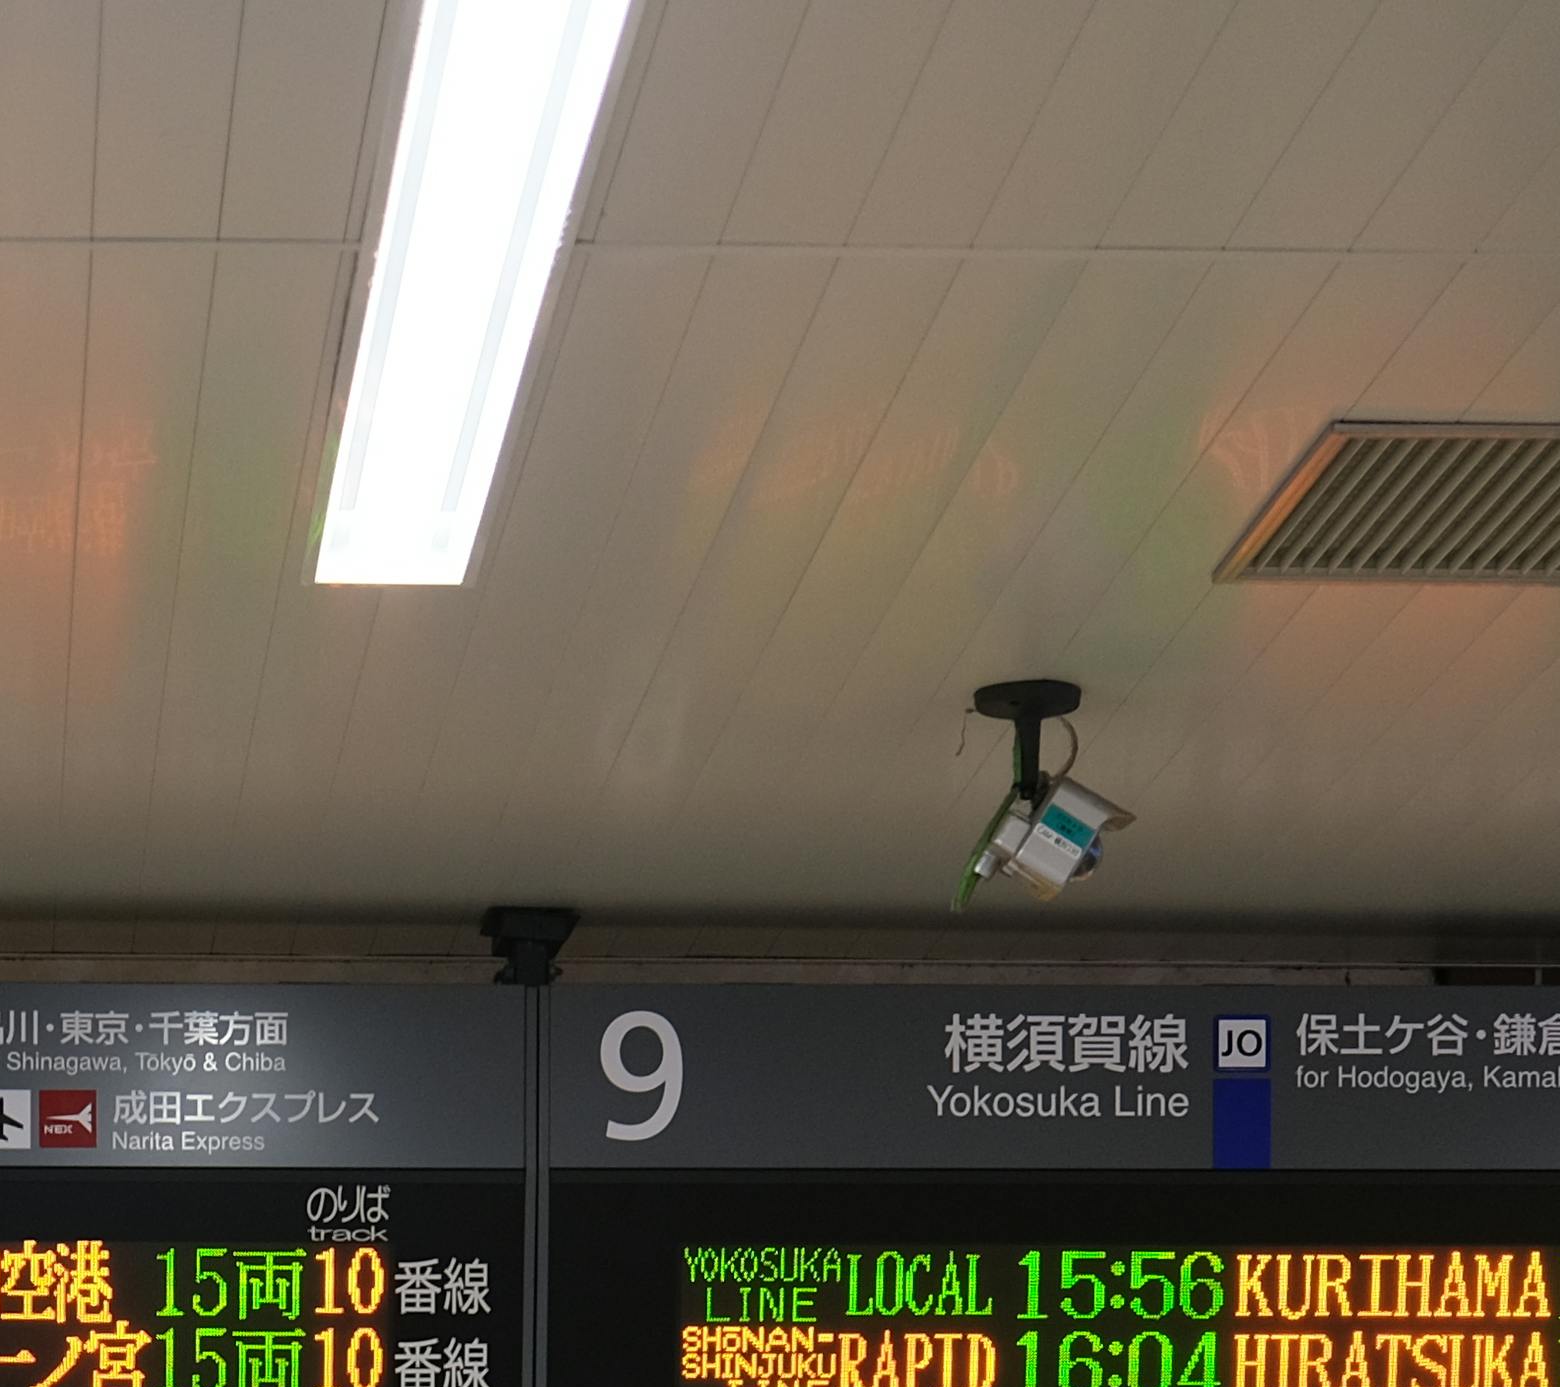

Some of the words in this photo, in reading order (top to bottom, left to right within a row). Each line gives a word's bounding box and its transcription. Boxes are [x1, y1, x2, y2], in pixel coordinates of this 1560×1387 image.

[944, 1012, 1189, 1074] 横須賀線
[1221, 1029, 1262, 1057] JO
[6, 1050, 127, 1077] Shinagawa,
[203, 1052, 218, 1072] &
[226, 1050, 286, 1072] Chiba
[599, 1010, 683, 1141] 9
[1296, 1066, 1330, 1088] for
[1337, 1065, 1473, 1093] Hodogaya,
[112, 1091, 380, 1125] 成田エクスプレス
[926, 1085, 1100, 1119] Yokosuka
[1115, 1085, 1189, 1117] Line
[112, 1130, 173, 1152] Narita
[181, 1130, 265, 1155] Express
[306, 1185, 390, 1224] のりば
[307, 1225, 388, 1243] track
[315, 1246, 385, 1315] 10
[394, 1257, 491, 1316] 番線
[684, 1246, 841, 1283] YOKOSUKA
[845, 1251, 993, 1317] LOCAL
[1017, 1250, 1225, 1320] 15:56
[1235, 1251, 1551, 1320] KURIHAMA
[705, 1287, 818, 1323] LINE
[682, 1352, 836, 1379] SHINJUKU
